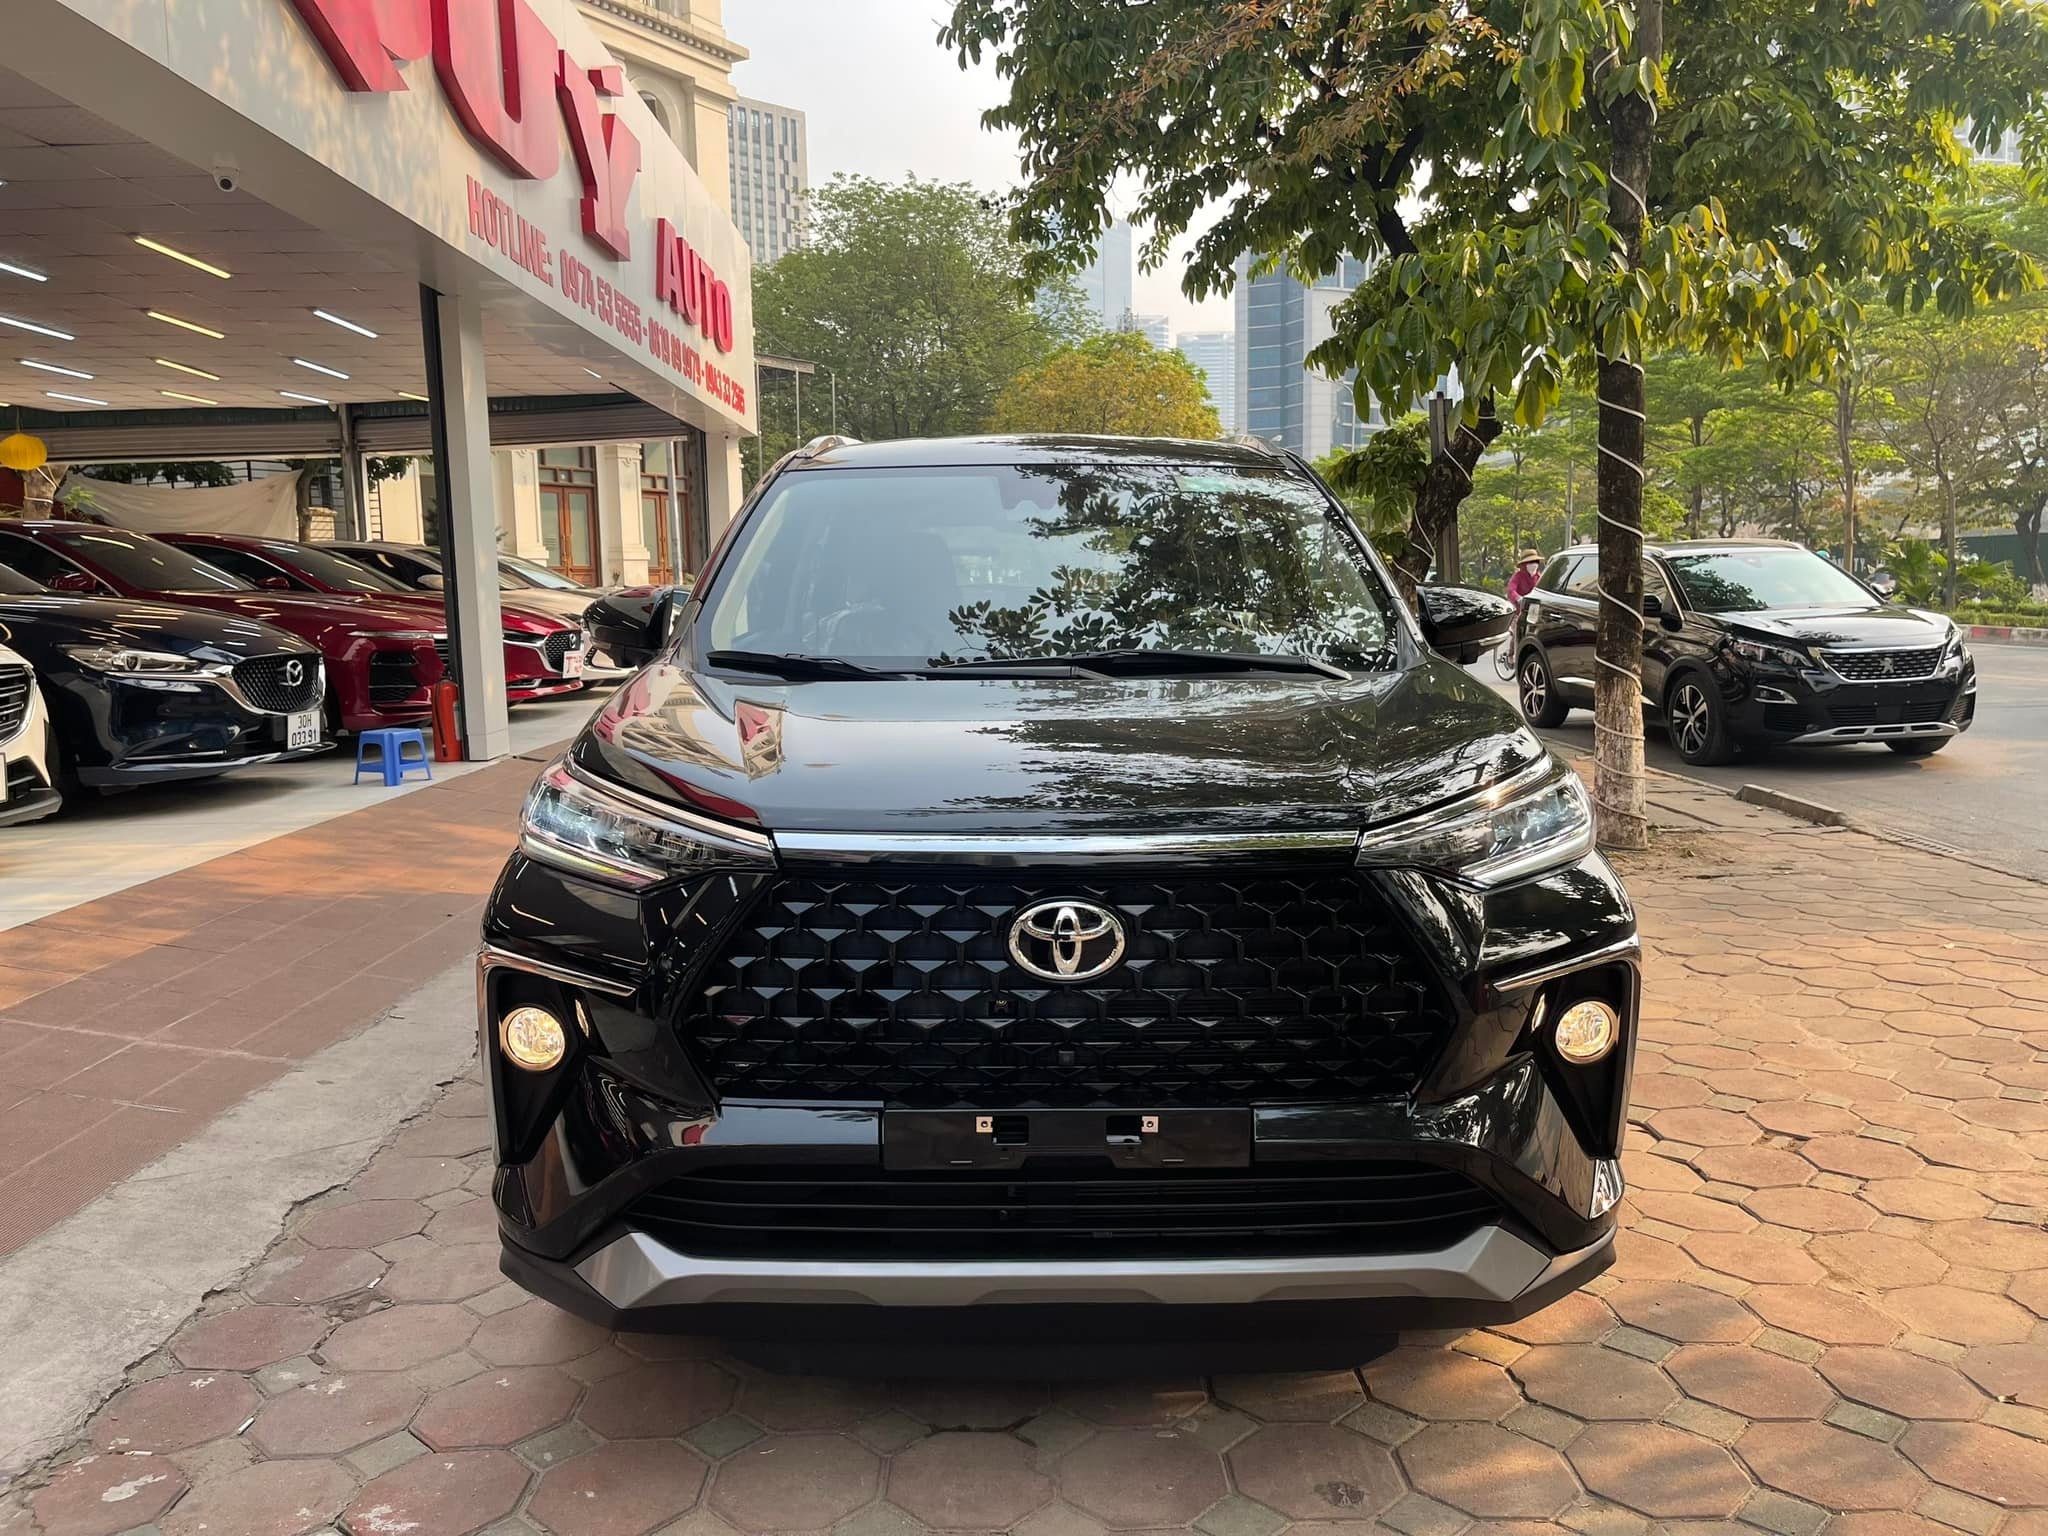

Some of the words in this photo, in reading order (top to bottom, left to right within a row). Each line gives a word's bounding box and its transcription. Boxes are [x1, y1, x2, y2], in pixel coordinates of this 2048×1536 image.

[466, 174, 553, 288] HOTLINE:
[560, 249, 595, 315] 0974
[597, 276, 613, 326] 53
[614, 289, 641, 345] 5555
[656, 218, 732, 353] AUTO
[298, 713, 312, 729] 30H
